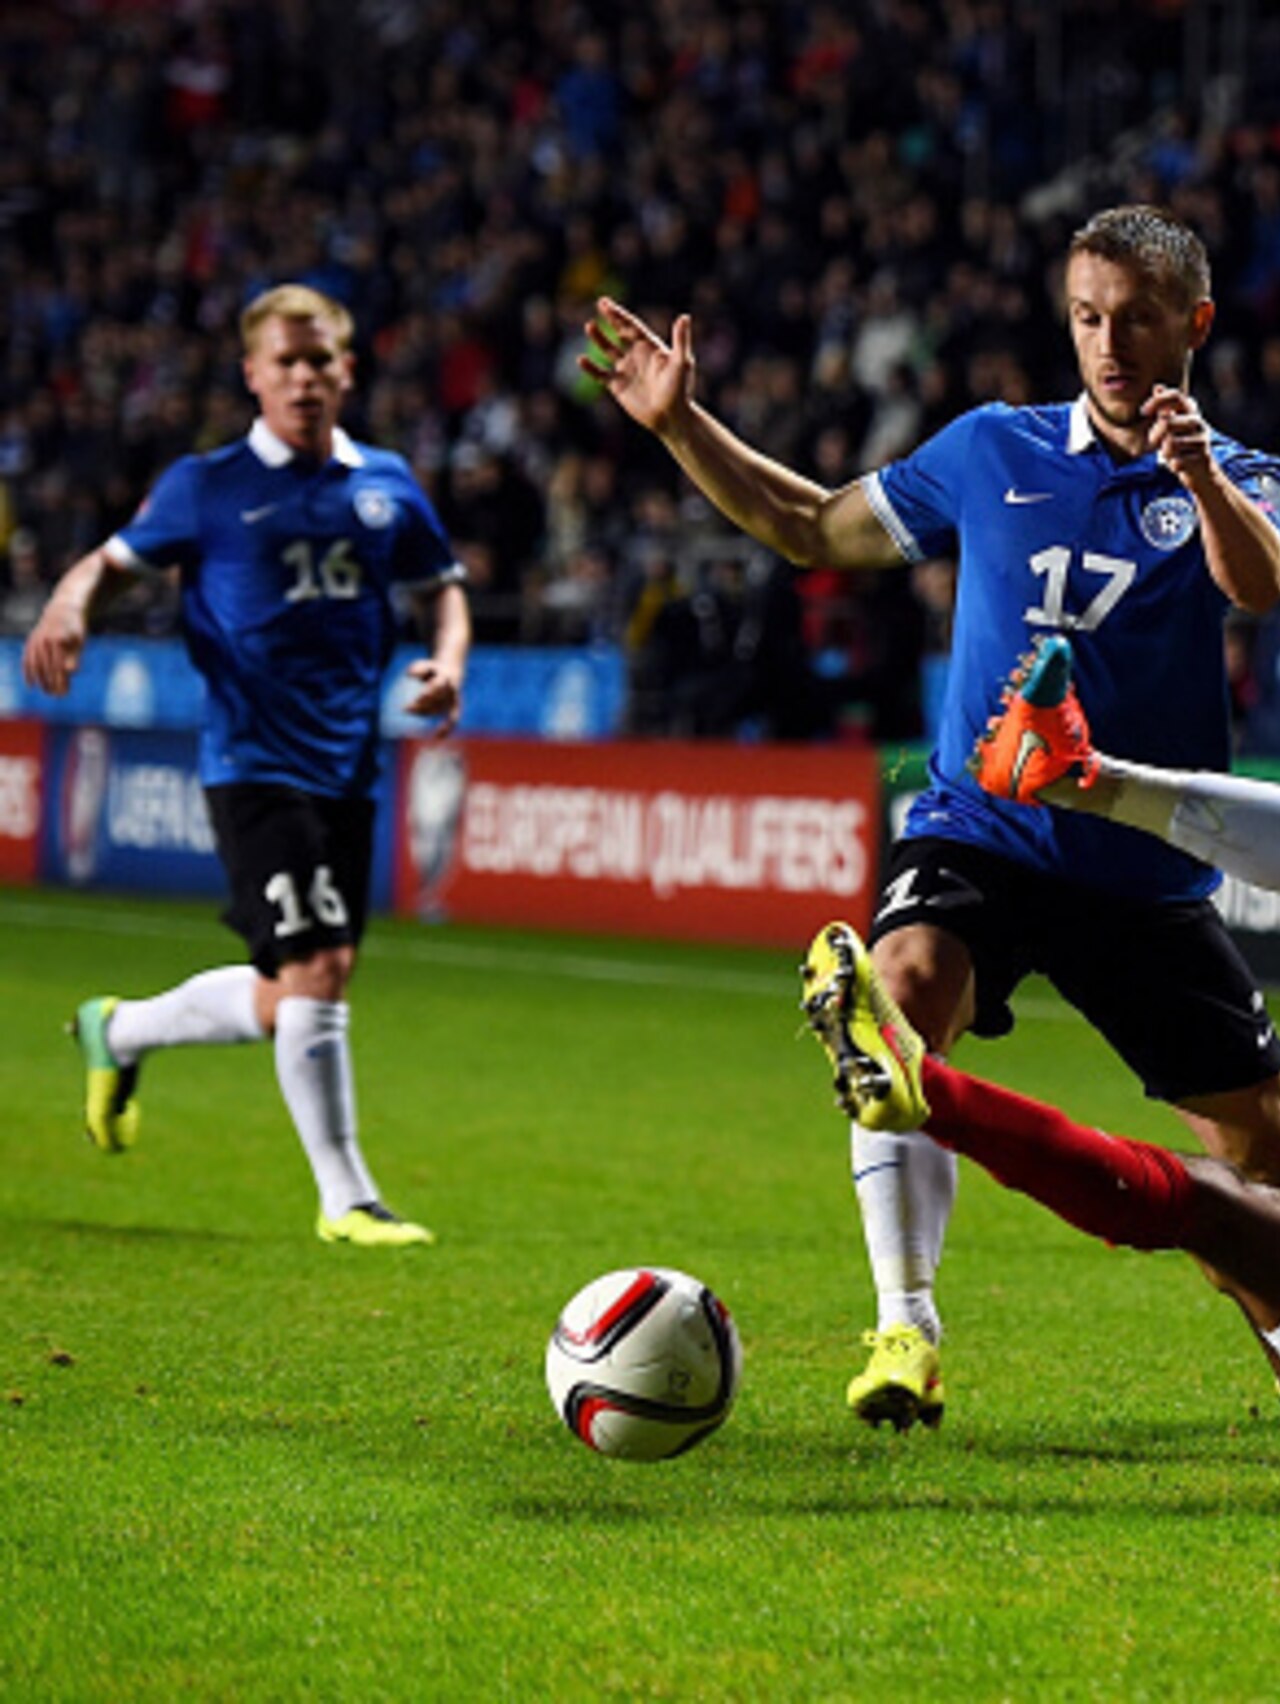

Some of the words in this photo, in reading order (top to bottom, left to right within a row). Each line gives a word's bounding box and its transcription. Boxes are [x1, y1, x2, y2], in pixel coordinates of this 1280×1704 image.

[282, 540, 361, 602] 16
[1022, 546, 1137, 633] 17
[463, 782, 643, 879] EUROPEAN
[649, 790, 870, 898] QUALIFIERS
[265, 865, 348, 937] 16
